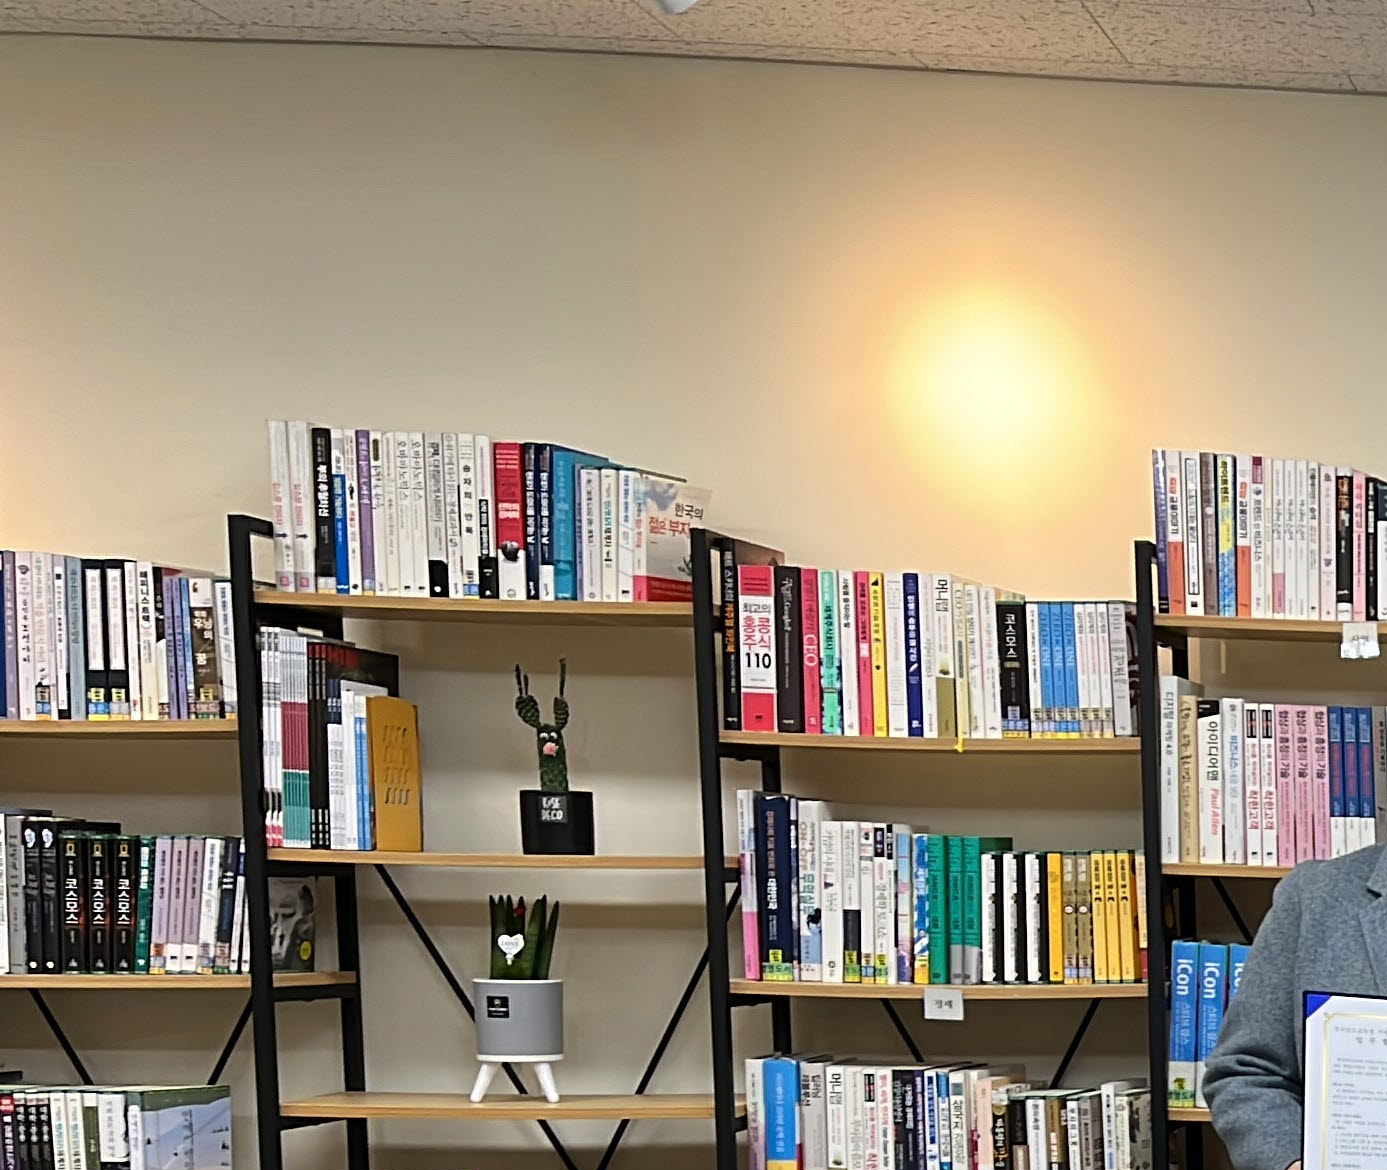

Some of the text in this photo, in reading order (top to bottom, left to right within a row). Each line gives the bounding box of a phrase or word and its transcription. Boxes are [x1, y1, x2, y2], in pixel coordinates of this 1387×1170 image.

[398, 440, 409, 500] 오바마노믹스
[411, 441, 423, 501] 오바마노믹스
[1220, 459, 1231, 504] 하이트렌드
[317, 483, 330, 517] 추월차선
[674, 502, 704, 520] 한국의
[648, 515, 667, 535] 젊은
[139, 569, 152, 623] 해피니스트랙
[742, 602, 772, 613] 최고의
[935, 578, 949, 613] 머니랩
[742, 616, 772, 634] 홍콩
[742, 634, 772, 652] 주식
[1004, 612, 1018, 659] 코스모스
[744, 652, 772, 669] 110
[804, 633, 817, 667] CEO
[1163, 692, 1175, 720] 디지털
[1279, 709, 1290, 779] 협상과 흥정의 기술
[1296, 709, 1307, 779] 협상과 흥정의 기술
[1315, 709, 1326, 779] 협상과 흥정의 기술
[1206, 720, 1220, 836] 아이디어맨 Paul Allen
[1248, 790, 1260, 830] 착한고객
[1264, 790, 1275, 831] 착한고객
[65, 878, 79, 924] 코스모스
[92, 878, 105, 924] 코스모스
[117, 878, 130, 924] 코스모스
[767, 878, 778, 910] 대한민국
[800, 873, 816, 916] 무역실무
[934, 1000, 953, 1009] 경제
[1176, 959, 1194, 1045] iCon 스티브 잡스
[1203, 962, 1221, 1031] iCon 스티브
[801, 1074, 811, 1107] 레볼루션
[811, 1074, 821, 1099] 딥러닝
[829, 1073, 844, 1105] 머니랩
[952, 1099, 964, 1130] 삼국지
